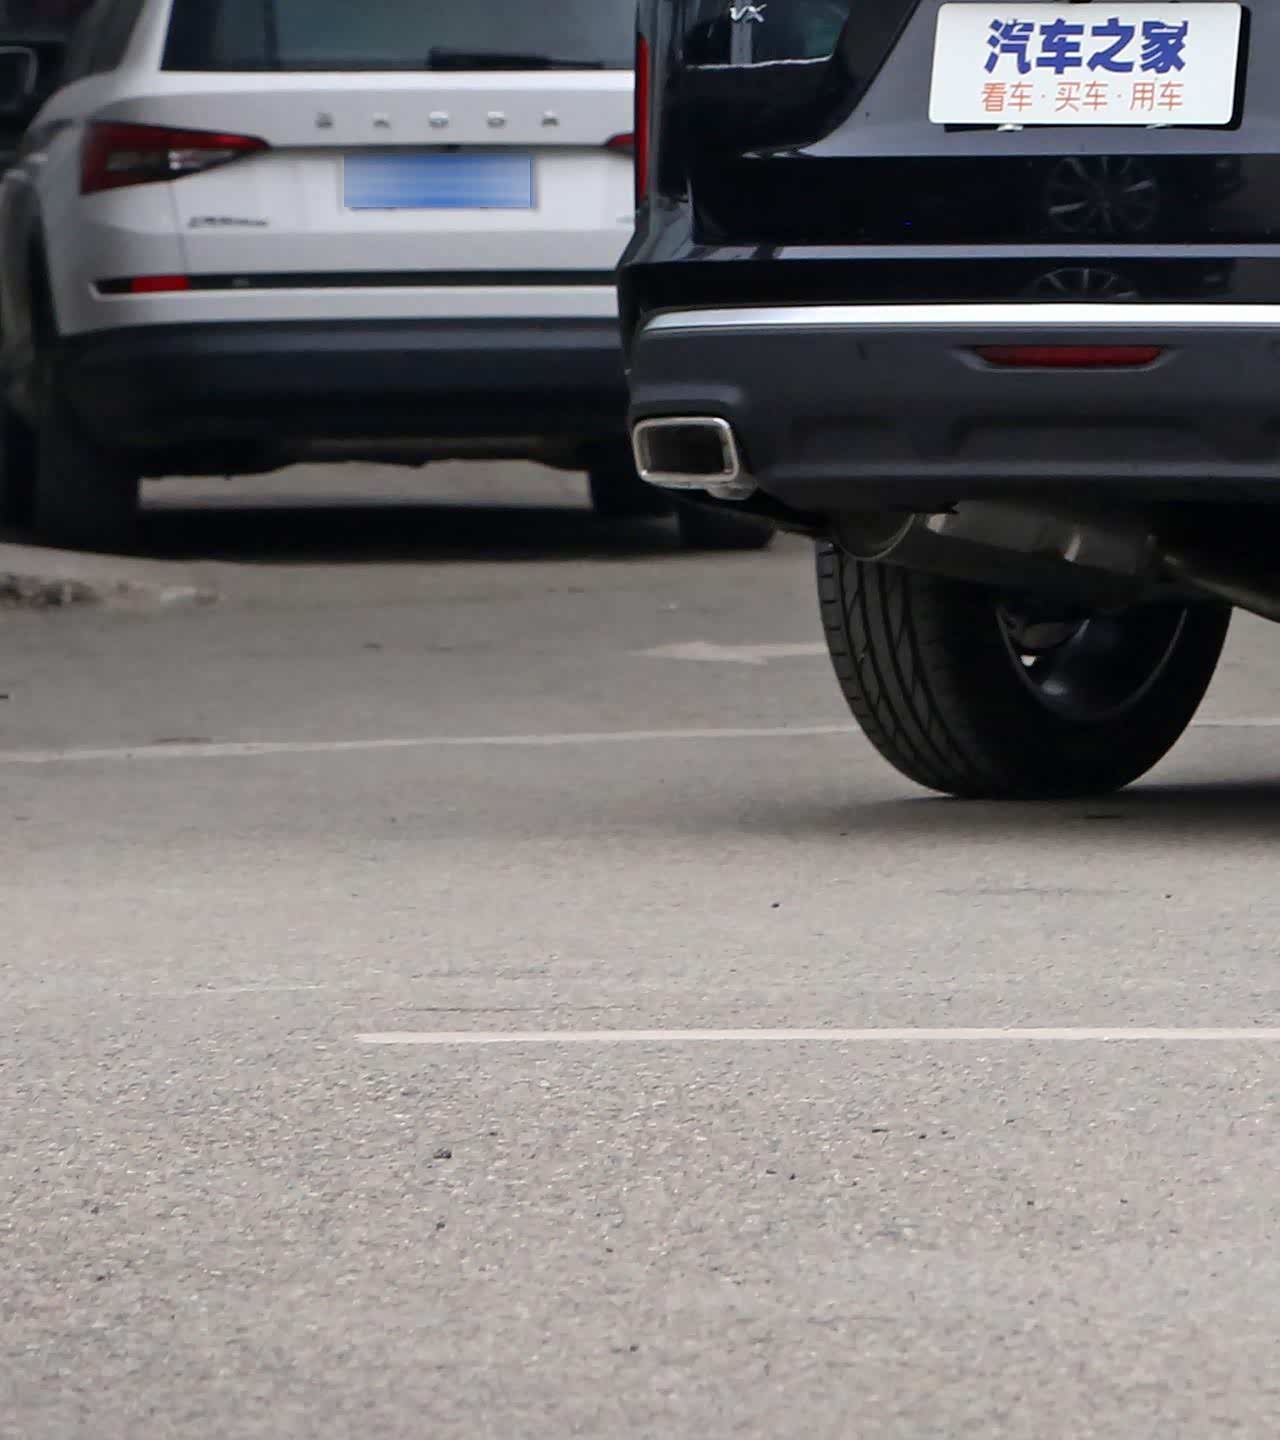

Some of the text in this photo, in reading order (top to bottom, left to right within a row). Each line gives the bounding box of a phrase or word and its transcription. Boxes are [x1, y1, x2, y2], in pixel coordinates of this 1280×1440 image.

[730, 3, 767, 23] VX
[984, 17, 1189, 74] 汽车之家
